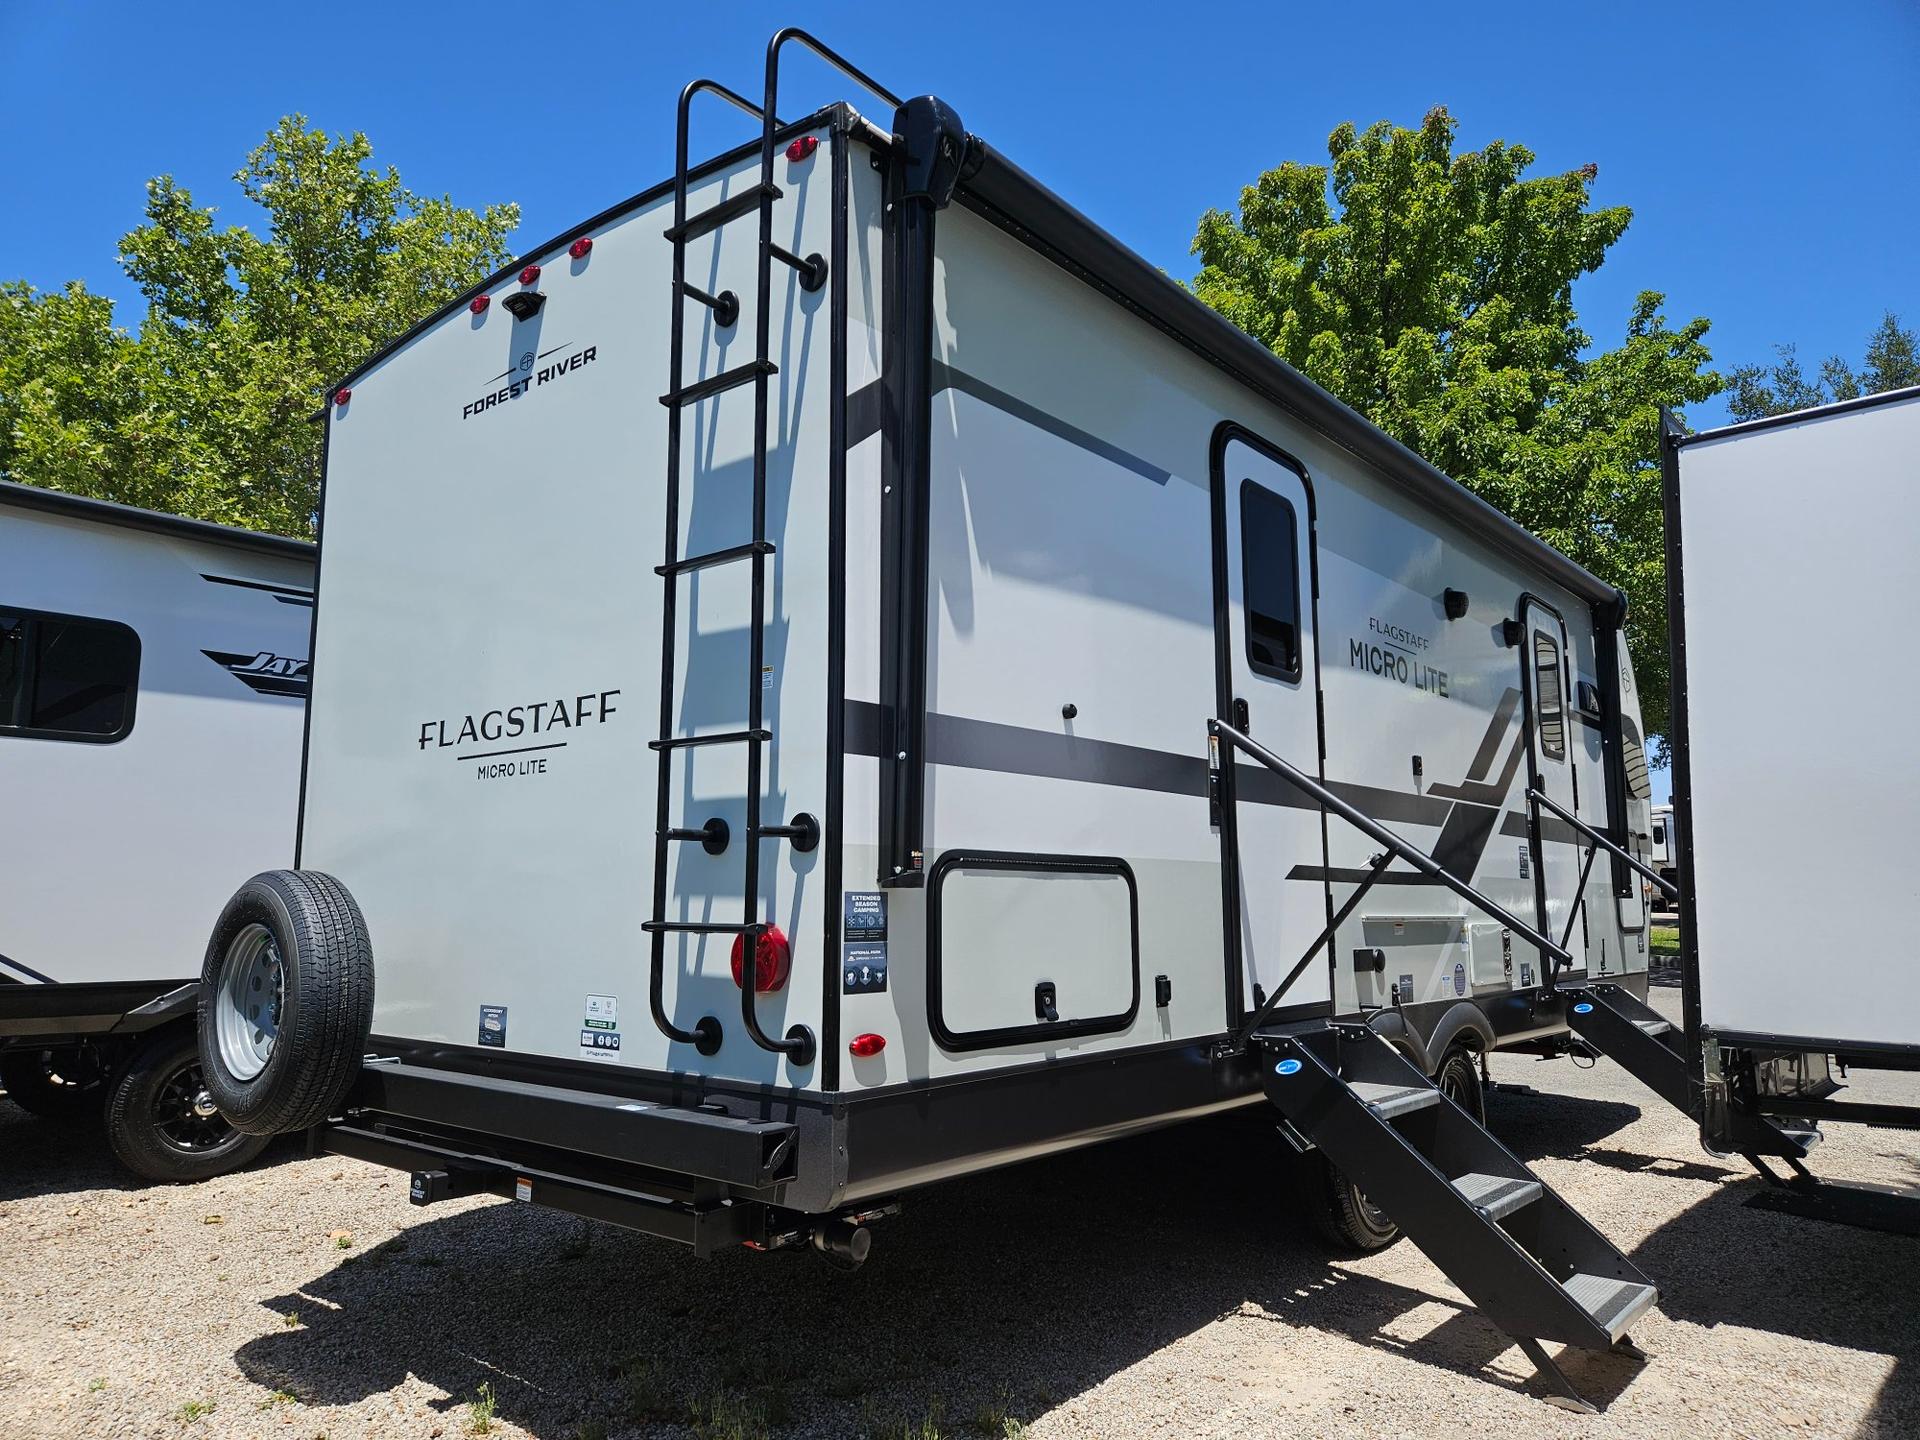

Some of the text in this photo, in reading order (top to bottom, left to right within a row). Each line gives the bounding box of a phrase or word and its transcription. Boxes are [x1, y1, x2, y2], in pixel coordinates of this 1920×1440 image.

[463, 345, 597, 420] FOREST RIVER
[1369, 617, 1429, 650] FLAGSTAFF
[1350, 638, 1449, 699] MICRO LITE
[418, 689, 621, 750] FLAGSTAFF
[477, 759, 547, 780] MICRO LITE
